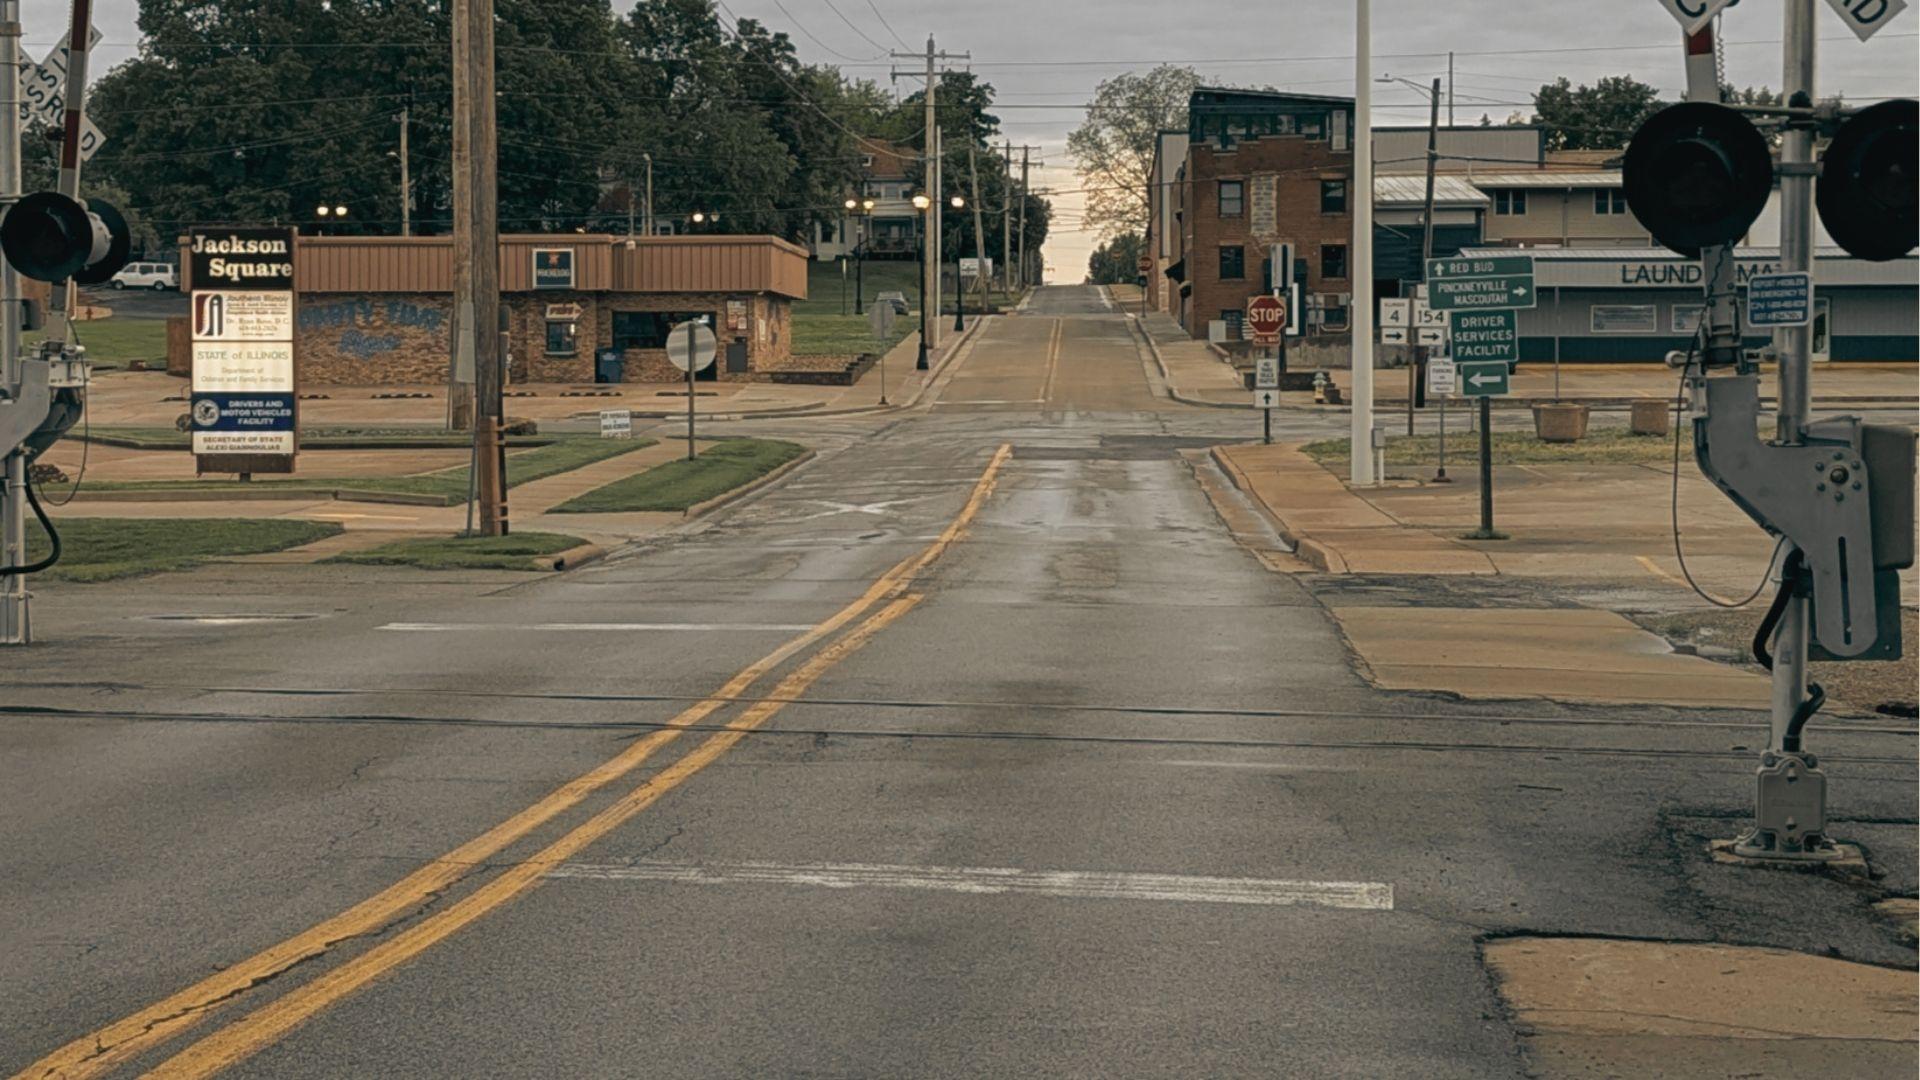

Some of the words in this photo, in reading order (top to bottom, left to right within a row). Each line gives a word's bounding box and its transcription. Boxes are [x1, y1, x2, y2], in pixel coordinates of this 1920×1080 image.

[191, 235, 287, 254] Jackson
[209, 258, 293, 281] Square
[1450, 263, 1469, 273] RED
[1474, 262, 1495, 272] BUD
[1621, 263, 1781, 284] LAUNDMA
[1437, 280, 1507, 293] PINCKNEYVILLE
[1454, 293, 1508, 305] MASCOUTAH
[1250, 308, 1284, 322] STOP
[1389, 310, 1400, 322] 4
[1418, 310, 1444, 323] 154
[1461, 315, 1505, 328] DRIVER
[1455, 330, 1513, 342] SERVICES
[197, 351, 228, 360] STATE
[232, 351, 242, 360] of
[247, 351, 289, 360] ILLINOIS
[1457, 345, 1511, 357] FACILITY
[228, 400, 263, 408] DRIVERS
[265, 400, 284, 408] AND
[221, 409, 251, 417] MOTOR
[252, 409, 292, 417] VEHICLES
